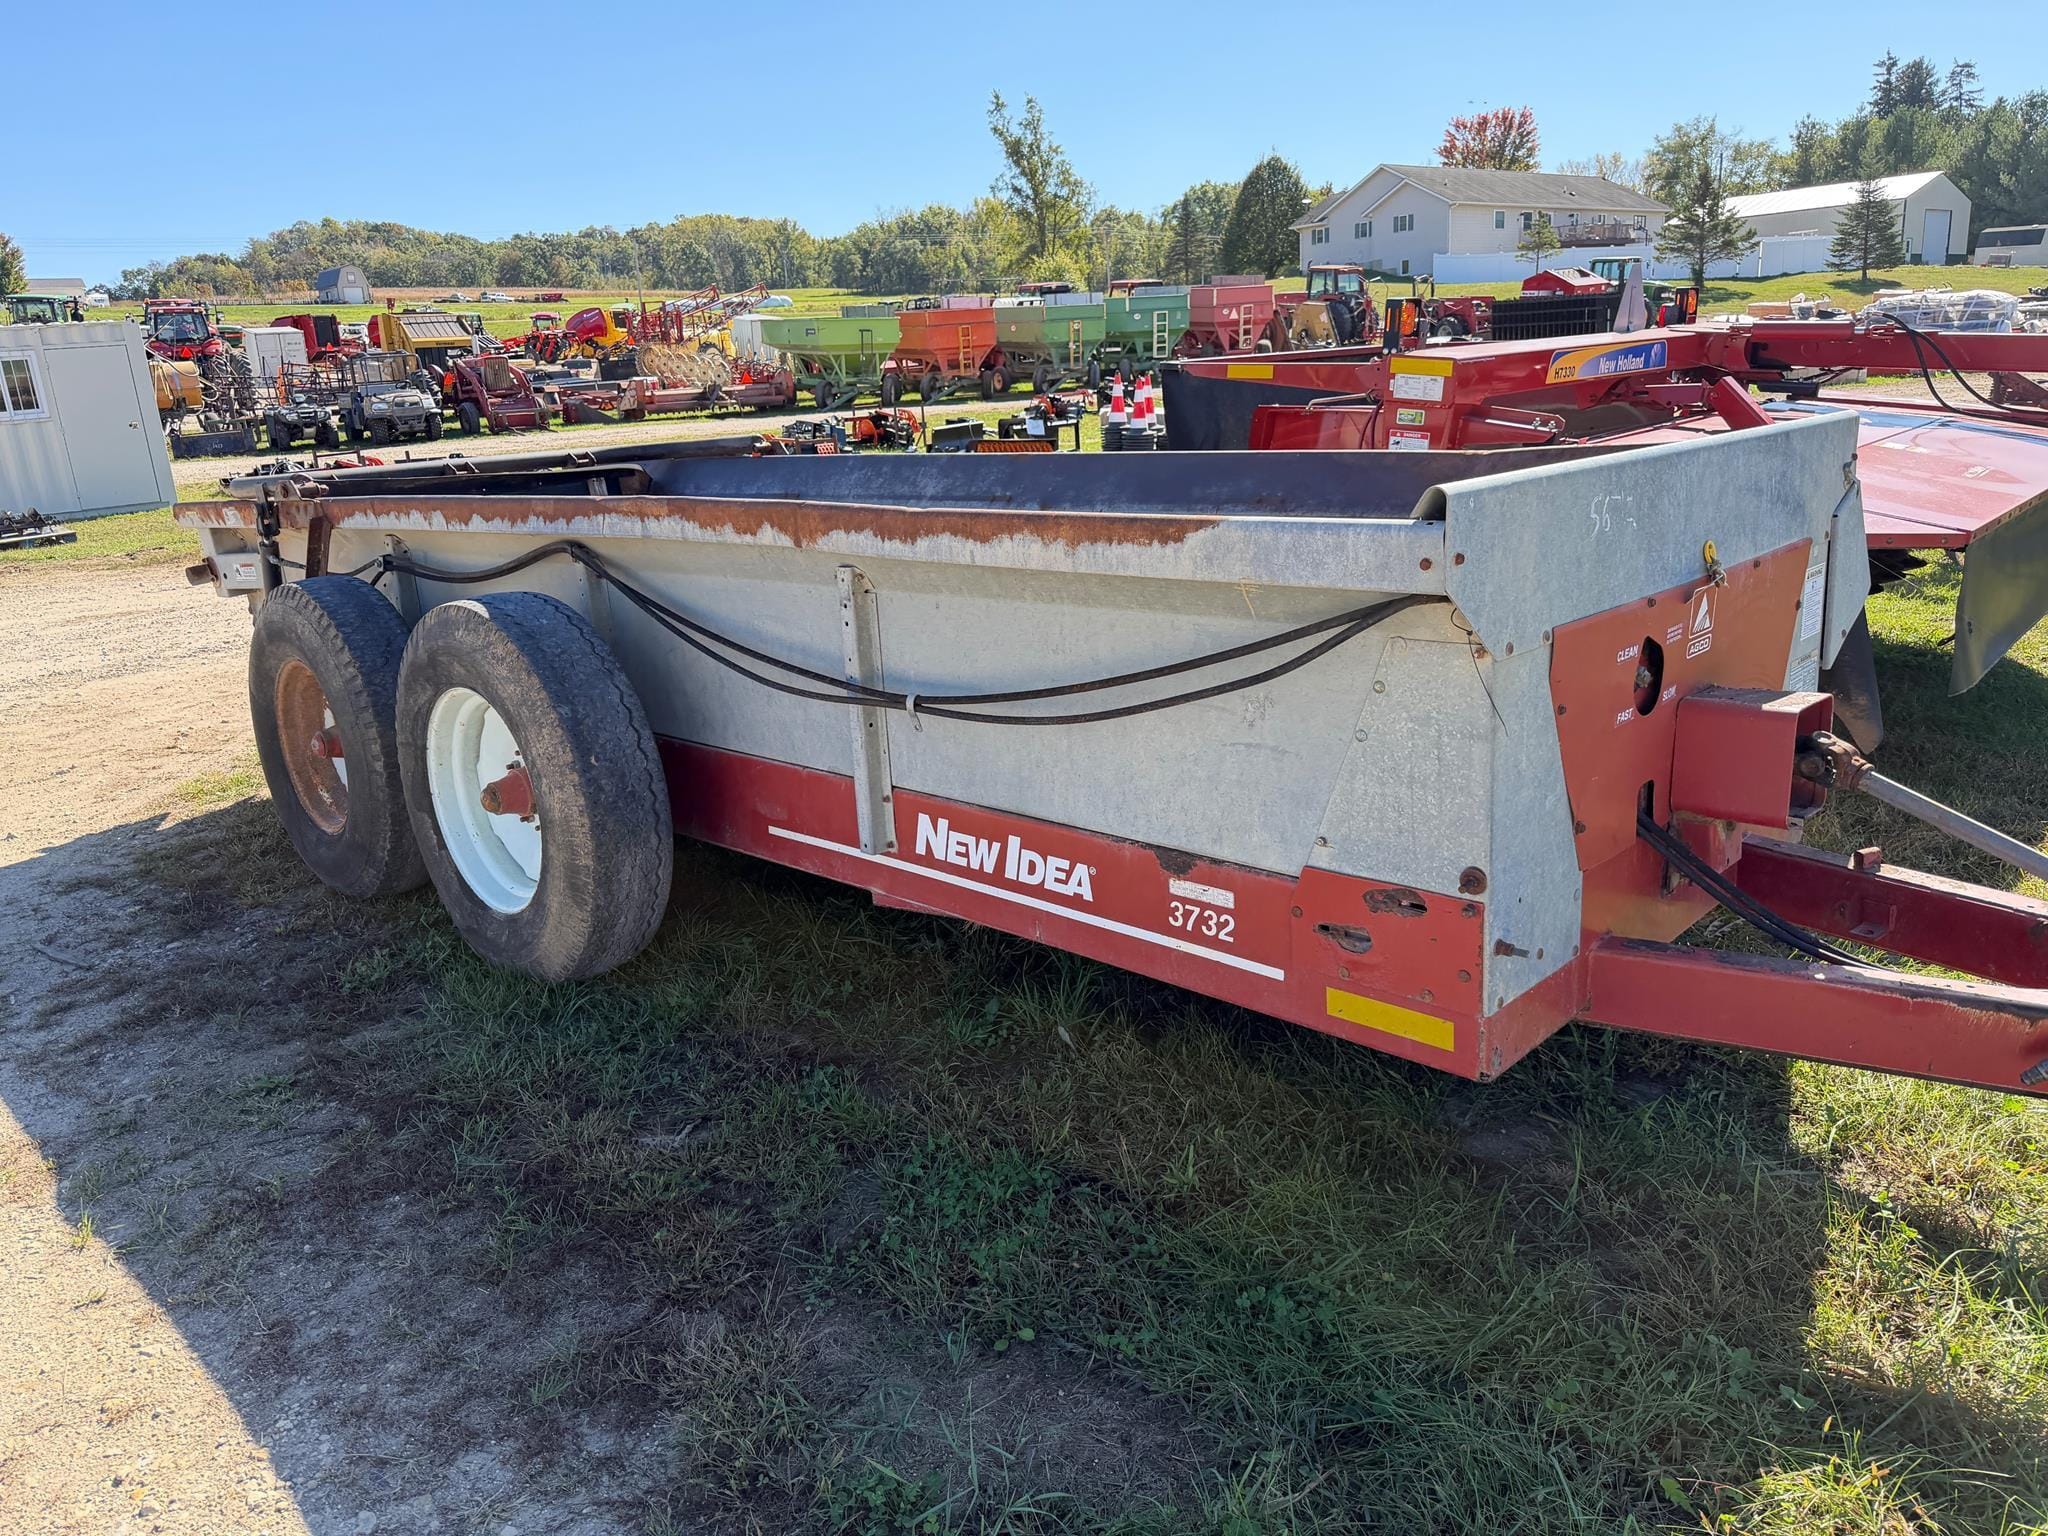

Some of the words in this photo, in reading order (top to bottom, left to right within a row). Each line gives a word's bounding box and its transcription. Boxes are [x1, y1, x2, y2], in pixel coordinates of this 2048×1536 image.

[1598, 357, 1616, 374] New
[1617, 352, 1645, 371] Holland
[1554, 365, 1576, 379] H7330
[1616, 645, 1639, 663] CLEAN
[1688, 638, 1709, 655] AGCO
[1662, 685, 1677, 701] SLOW
[1616, 708, 1633, 724] FAST
[915, 812, 1001, 874] NEW
[1168, 901, 1235, 943] 3732
